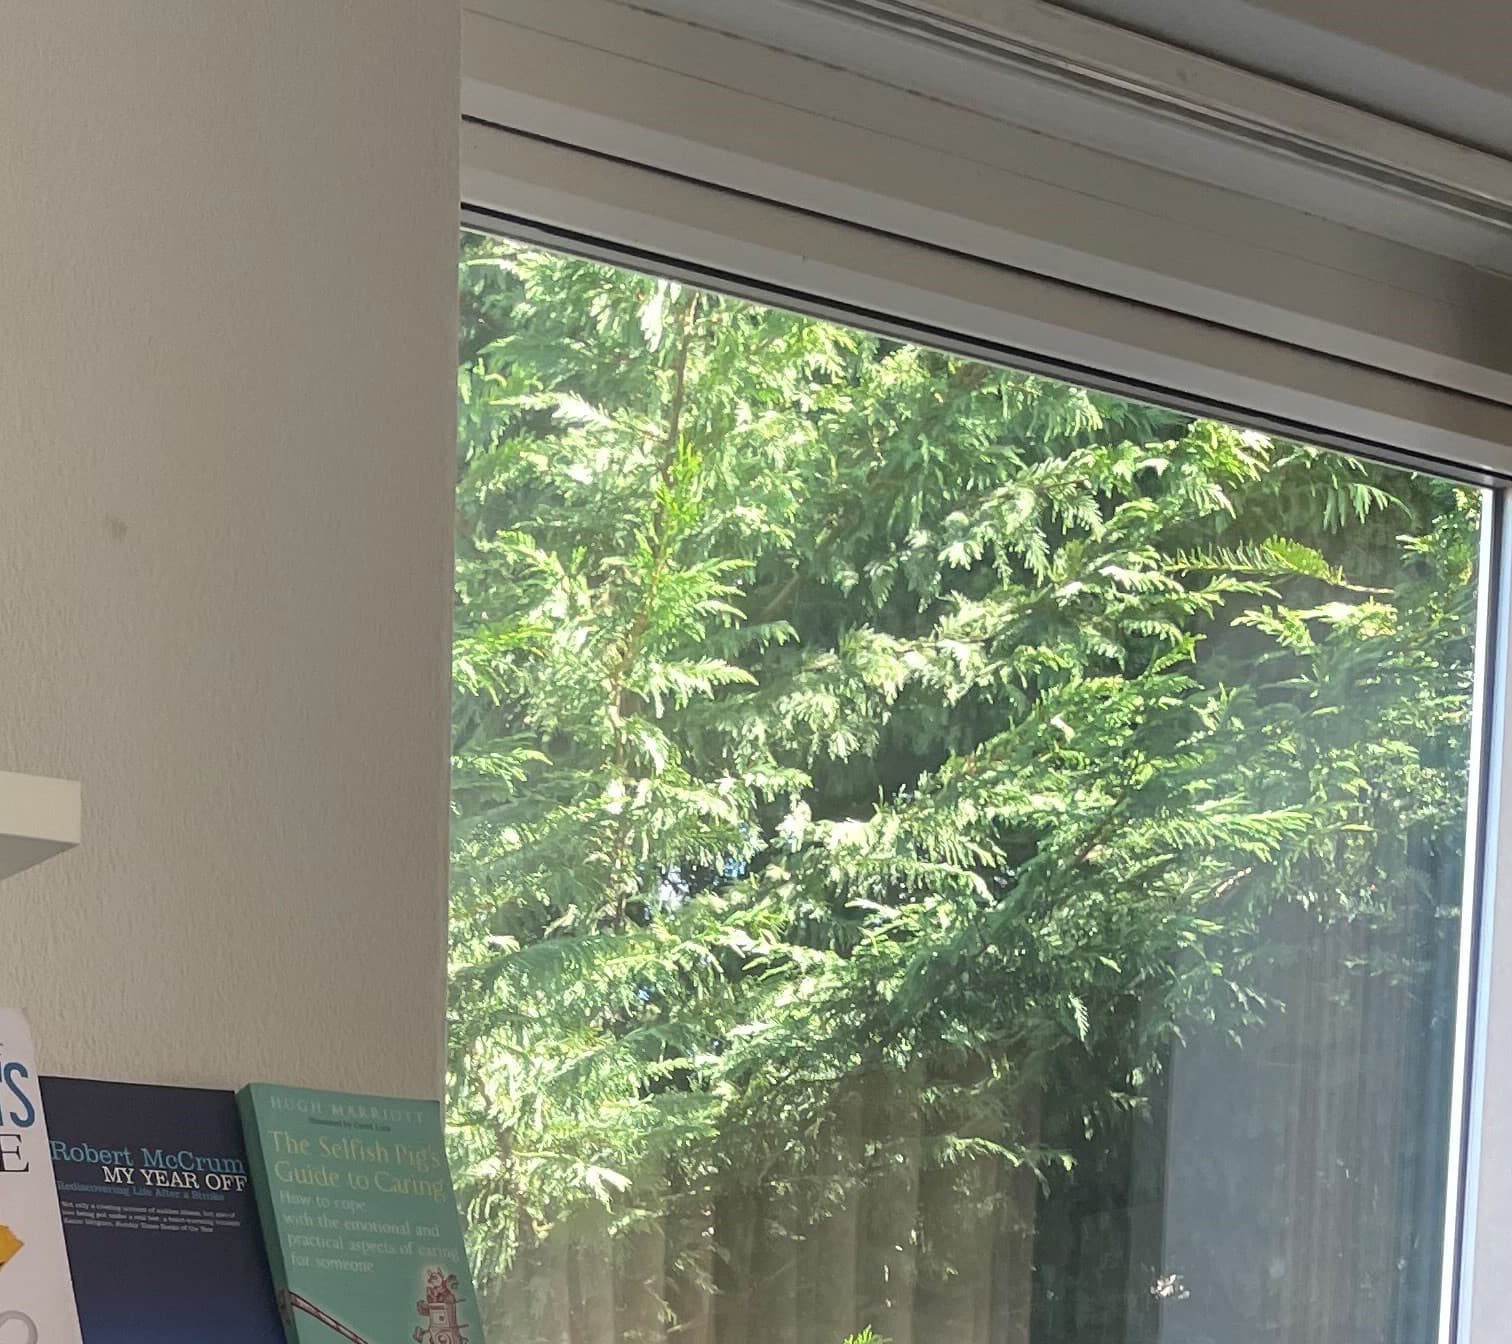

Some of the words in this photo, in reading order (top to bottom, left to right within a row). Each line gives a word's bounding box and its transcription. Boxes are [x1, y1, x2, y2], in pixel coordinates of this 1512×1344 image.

[50, 1141, 134, 1166] Robert
[140, 1148, 246, 1173] McCrum
[102, 1166, 134, 1184] MY
[140, 1169, 199, 1189] YEAR
[205, 1174, 247, 1191] OFF
[274, 1160, 339, 1186] Guide
[348, 1173, 369, 1190] to
